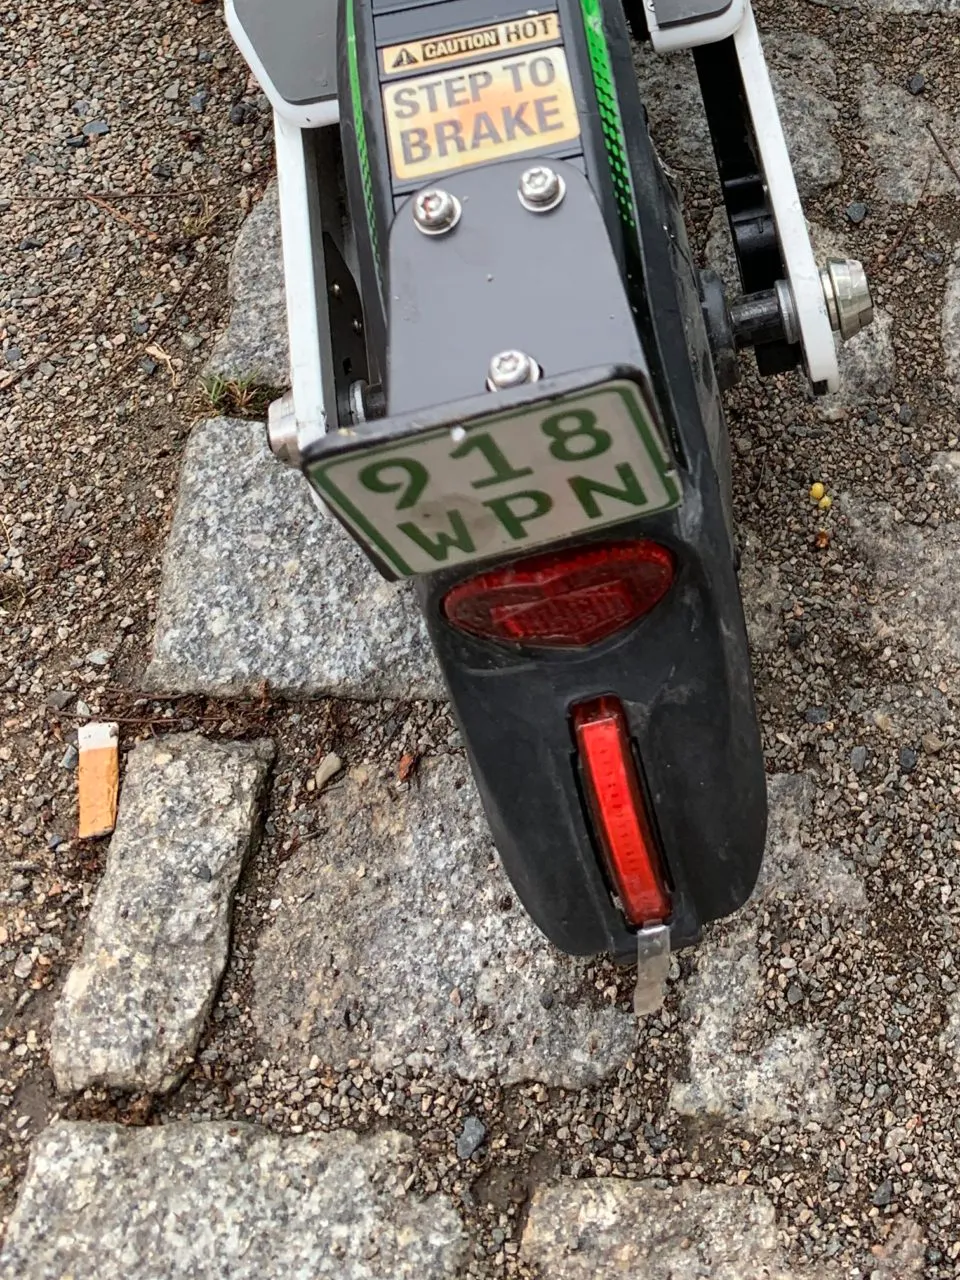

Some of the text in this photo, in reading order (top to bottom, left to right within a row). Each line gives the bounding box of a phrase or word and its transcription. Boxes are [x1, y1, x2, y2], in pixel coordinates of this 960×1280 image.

[424, 17, 552, 59] CAUTION HOT
[393, 56, 556, 119] STEP TO
[400, 96, 564, 165] BRAKE
[358, 408, 612, 511] 918
[397, 462, 648, 562] WPN
